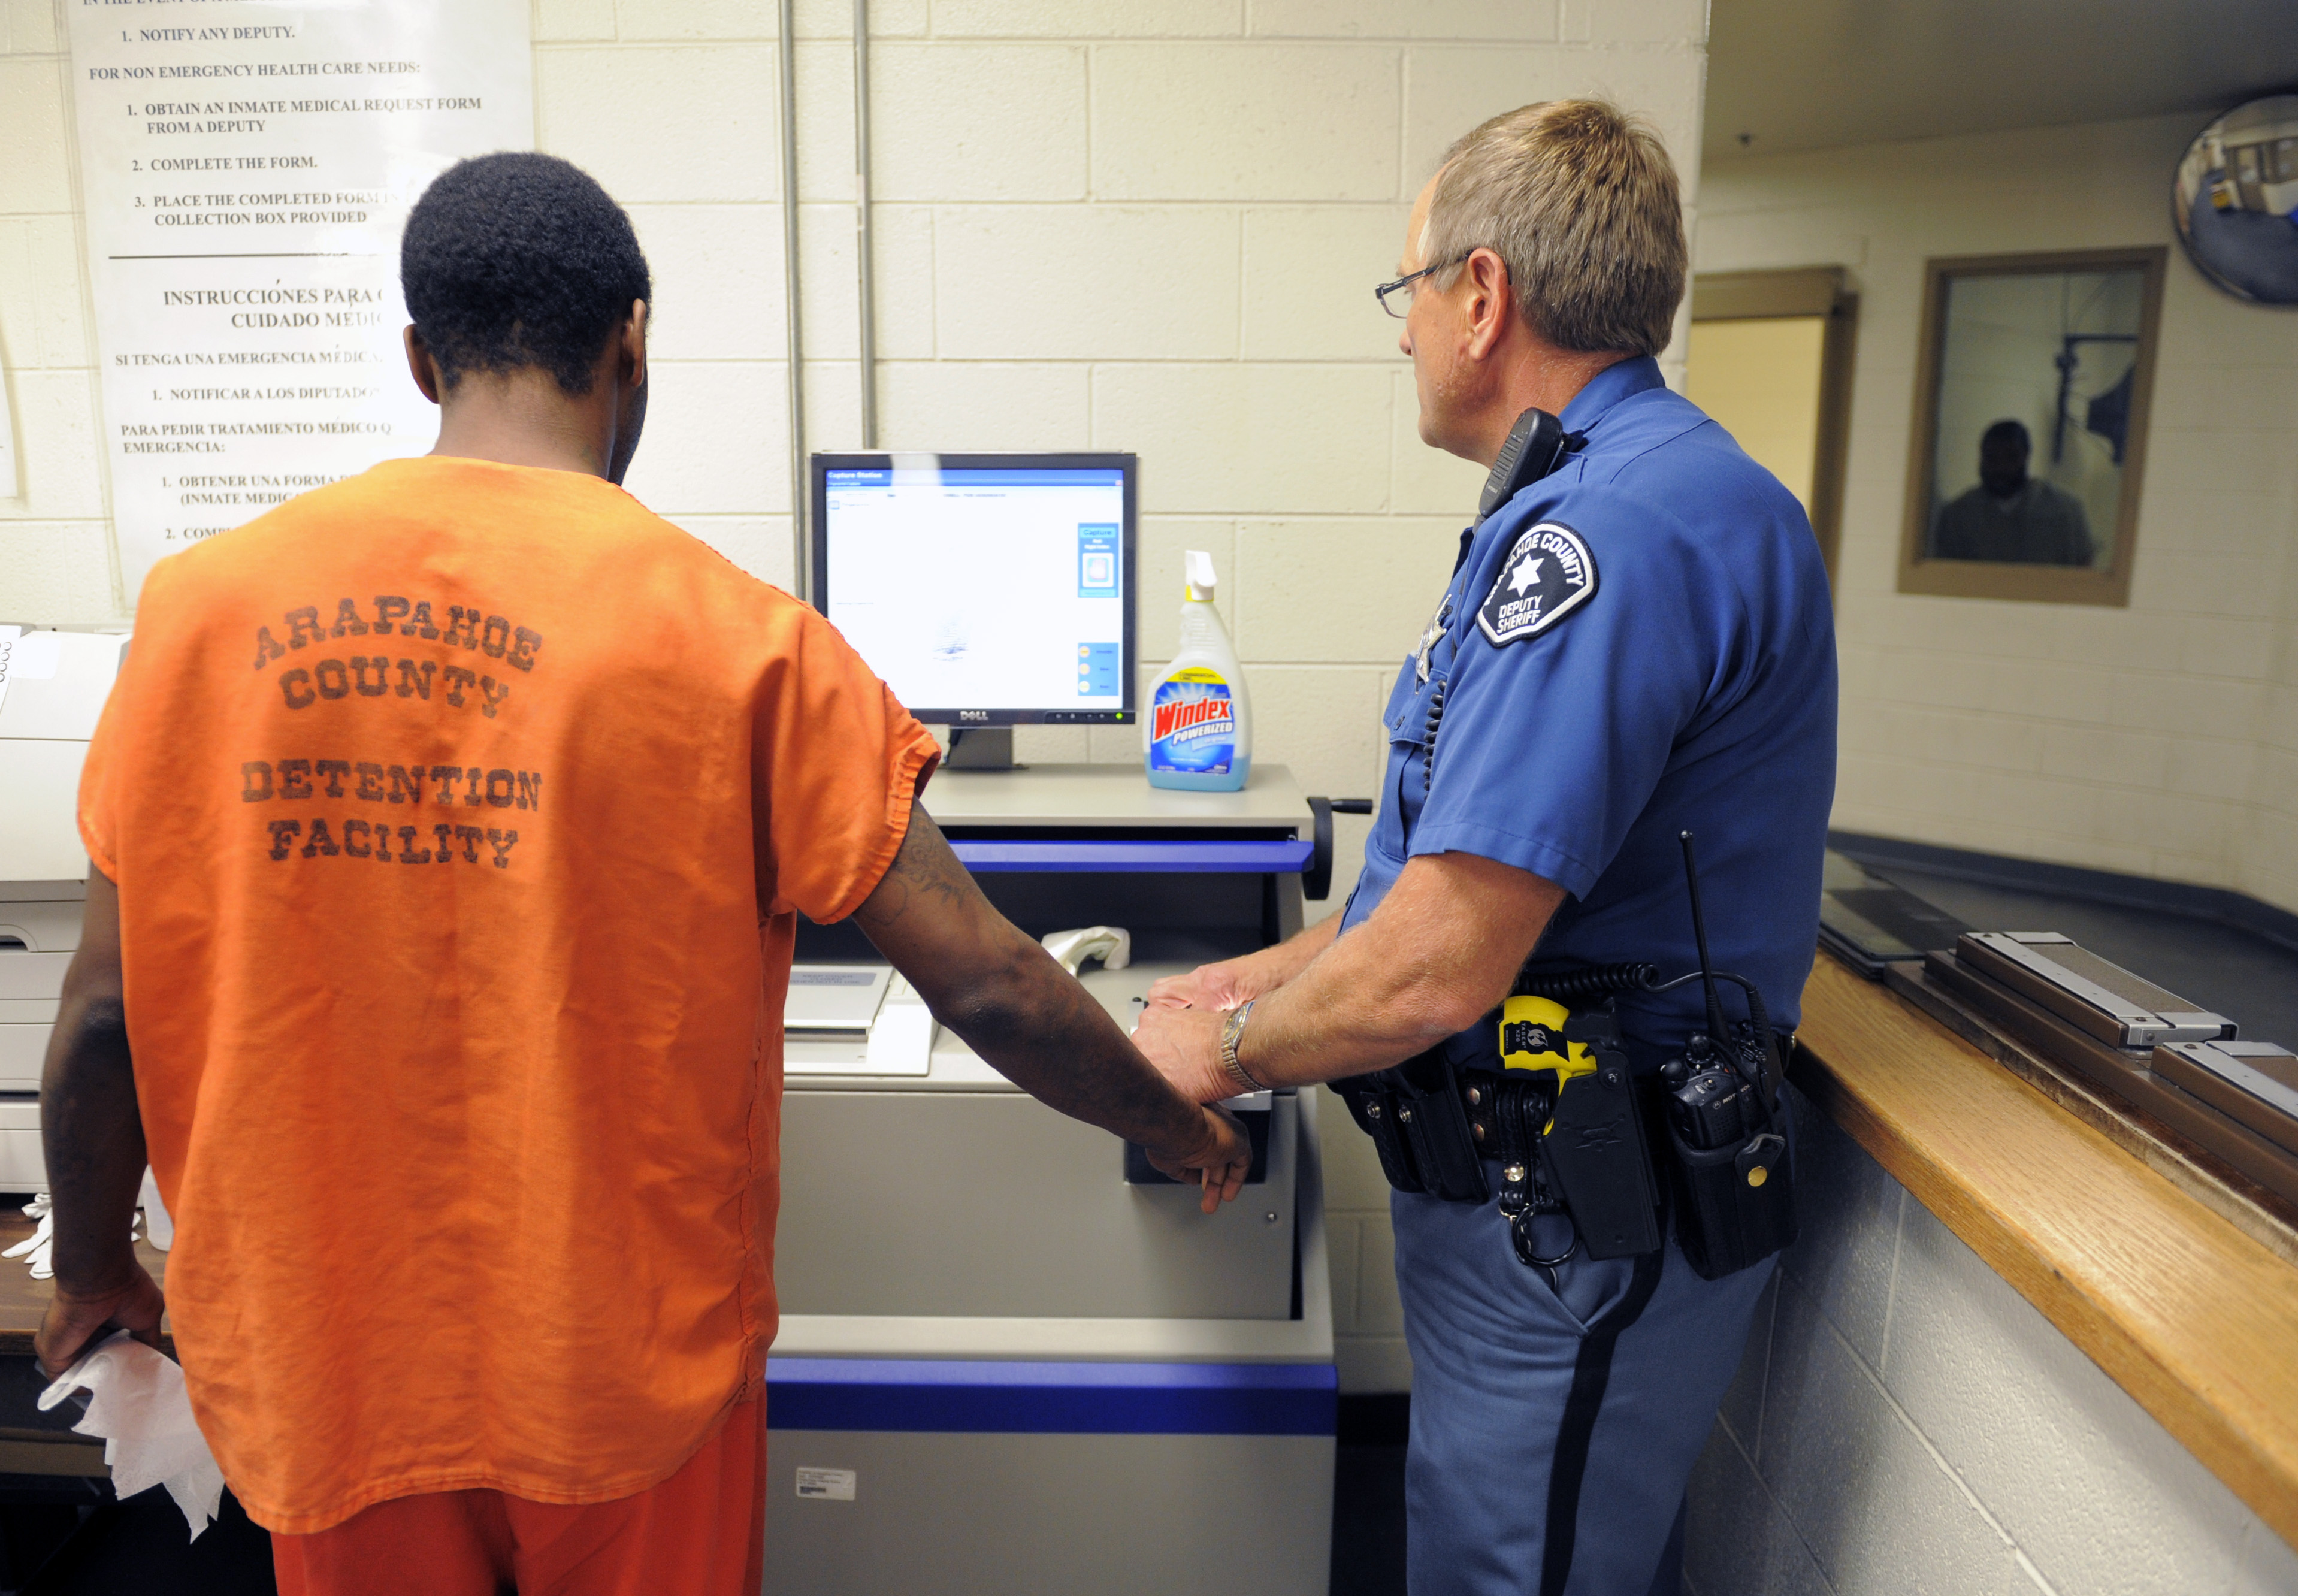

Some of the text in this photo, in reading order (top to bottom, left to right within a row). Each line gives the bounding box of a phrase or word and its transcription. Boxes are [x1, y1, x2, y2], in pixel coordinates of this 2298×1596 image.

[122, 26, 295, 42] 1. NOTIFY ANY DEPUTY.
[90, 62, 421, 80] FOR NON EMERGENCY HEALTH CARE NEEDS:
[127, 98, 482, 116] 1. OBTAIN AN INMATE MEDICAL REQUEST FORM
[147, 120, 265, 134] FROM A DEPUTY
[132, 156, 318, 171] 2. COMPLETE THE FORM.
[135, 197, 145, 207] 3.
[153, 195, 201, 207] PLACE
[205, 195, 235, 205] THE
[239, 193, 331, 206] COMPLETED
[336, 192, 379, 204] FORM
[155, 211, 367, 226] COLLECTION BOX PROVIDED
[324, 288, 371, 303] PARA
[231, 312, 319, 328] CUIDADO
[116, 355, 128, 365] SI
[132, 354, 182, 365] TENGA
[185, 354, 214, 364] UNA
[219, 352, 316, 364] EMERGENCIA
[153, 390, 162, 400] 1.
[171, 388, 250, 400] NOTIFICAR
[254, 389, 263, 399] A
[267, 388, 294, 399] LOS
[122, 425, 158, 436] PARA
[162, 424, 205, 436] PEDIR
[208, 422, 313, 435] TRATAMIENTO
[123, 441, 225, 454] EMERGENCIA:
[162, 477, 171, 487] 1.
[179, 476, 247, 488] OBTENER
[251, 476, 280, 486] UNA
[284, 474, 336, 486] FORMA
[180, 492, 299, 507] (INMATE MEDIC
[165, 528, 231, 539] 2. COM
[1540, 533, 1584, 587] COUNTY
[1498, 594, 1543, 619] DEPUTY
[1497, 609, 1541, 634] SHERIFF
[253, 595, 543, 673] ARAPAHOE
[279, 655, 509, 720] COUNTY
[960, 711, 988, 720] DELL
[1154, 697, 1231, 741] Windex
[1172, 721, 1234, 746] POWERIZED
[241, 758, 543, 812] DETENTION
[267, 818, 519, 869] FACILITY
